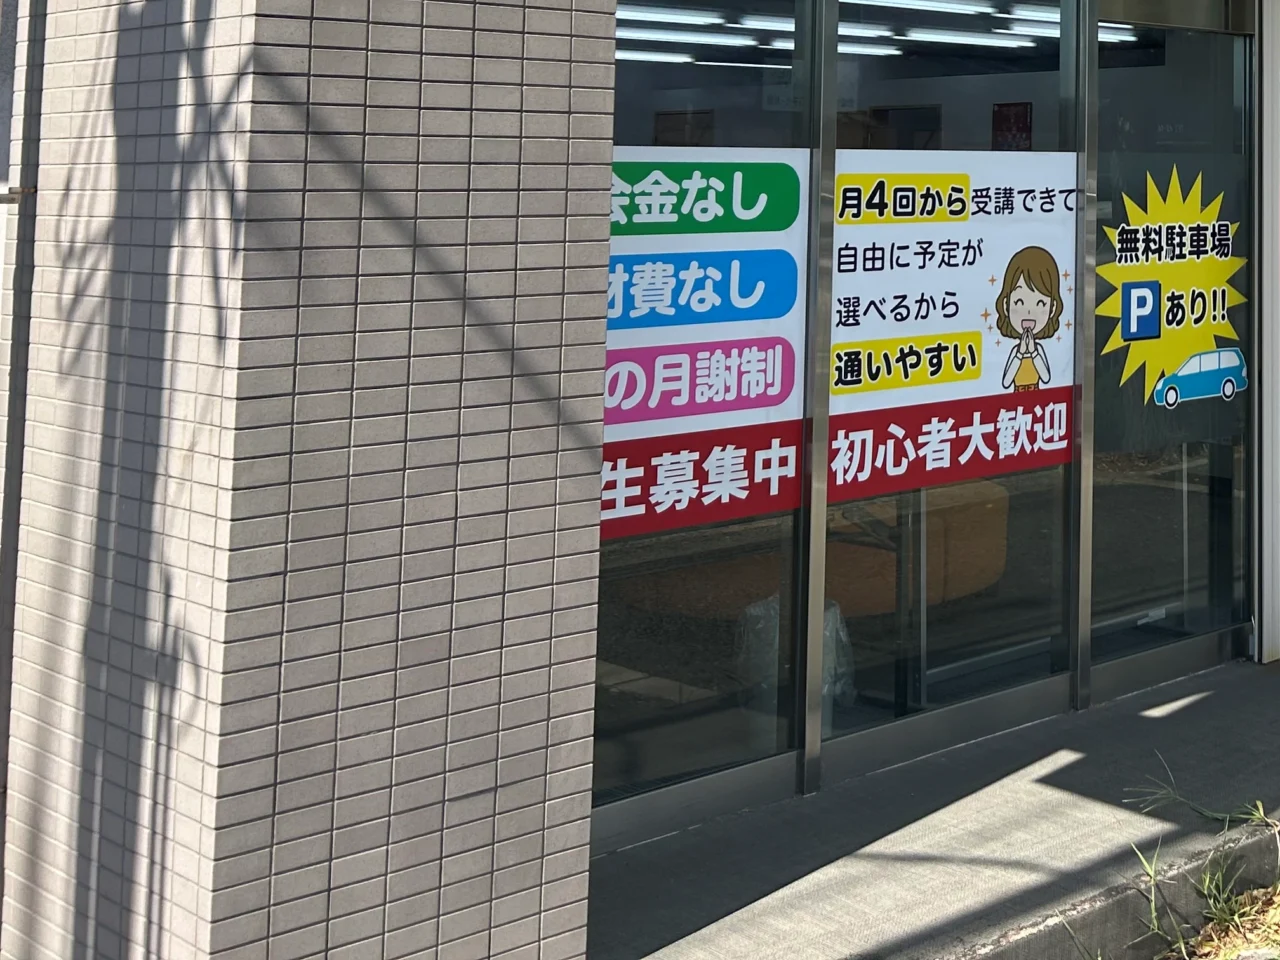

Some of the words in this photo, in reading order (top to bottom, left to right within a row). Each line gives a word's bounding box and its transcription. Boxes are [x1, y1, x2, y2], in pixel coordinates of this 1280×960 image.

[838, 180, 1076, 219] 月4回から受講できて
[837, 238, 984, 273] 自由に予定が
[1116, 223, 1231, 264] 無料駐車場
[836, 291, 960, 328] 選べるから
[1130, 288, 1153, 332] P
[604, 344, 783, 410] の月謝制
[833, 343, 977, 387] 通いやすい
[830, 402, 1068, 486] 初心者大歓迎
[600, 438, 797, 520] 生募集中
